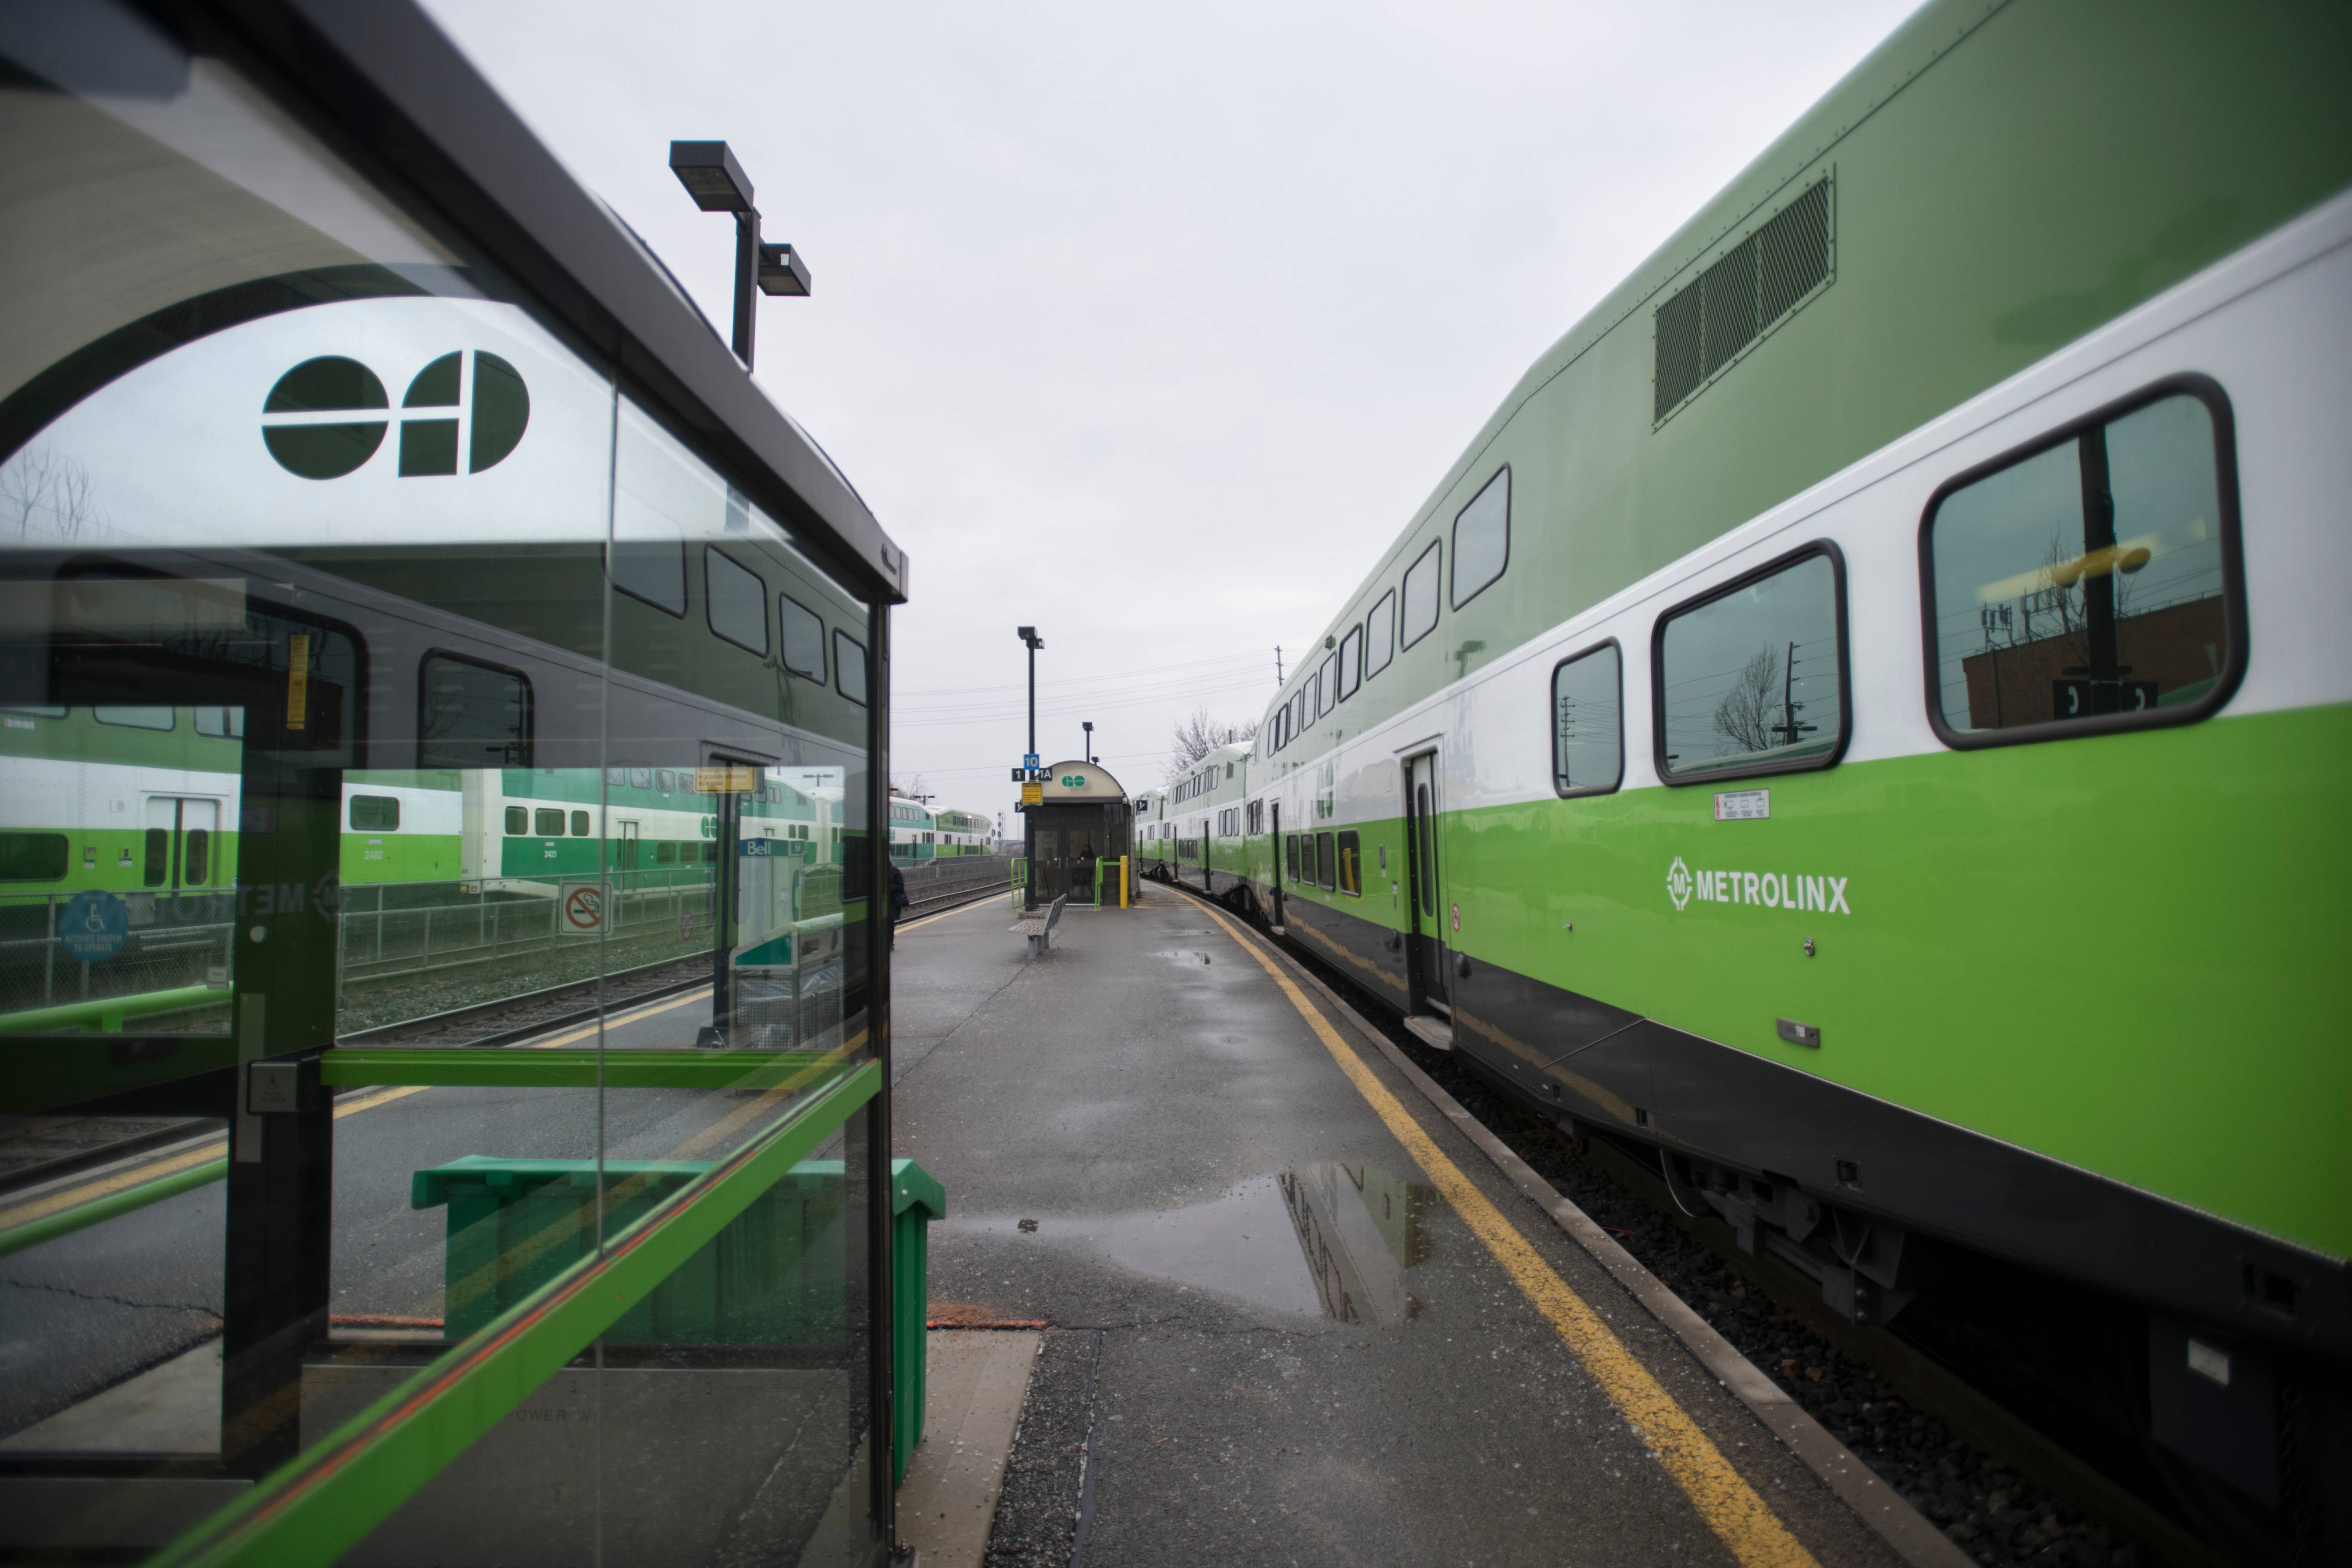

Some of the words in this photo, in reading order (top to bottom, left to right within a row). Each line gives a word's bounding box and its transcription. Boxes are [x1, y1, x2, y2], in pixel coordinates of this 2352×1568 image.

[1025, 757, 1038, 767] 10
[1015, 770, 1021, 779] 1
[1039, 770, 1051, 779] 1A
[1061, 775, 1085, 787] GO
[747, 841, 771, 855] Bell
[365, 850, 383, 860] 2402
[1696, 870, 1851, 915] METROLINX
[65, 934, 95, 942] ACTIVATE
[96, 934, 122, 942] SWITCH
[74, 944, 82, 952] TO
